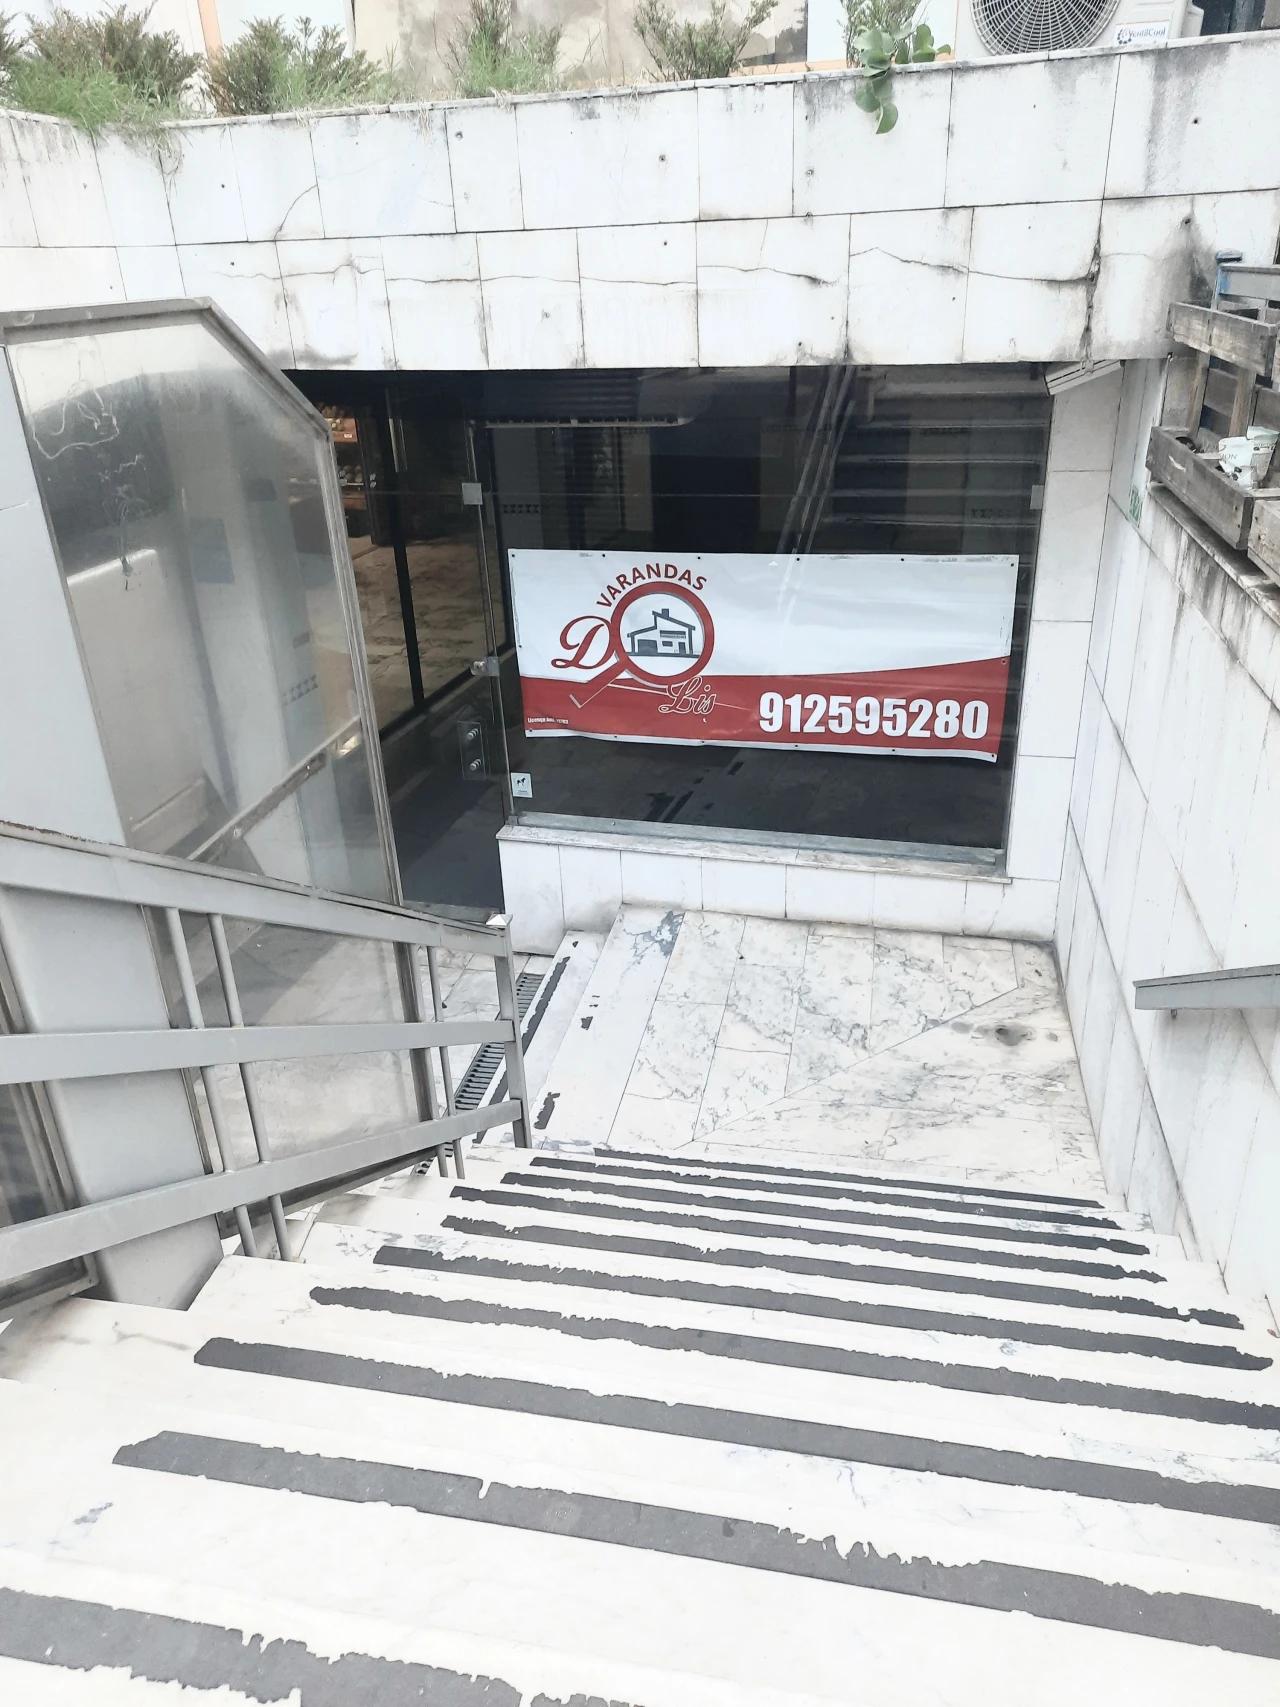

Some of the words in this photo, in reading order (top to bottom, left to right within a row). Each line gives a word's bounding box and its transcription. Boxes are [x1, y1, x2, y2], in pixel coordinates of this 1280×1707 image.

[596, 563, 707, 608] VARANDAS
[658, 675, 717, 715] Lis
[759, 691, 990, 740] 912595280
